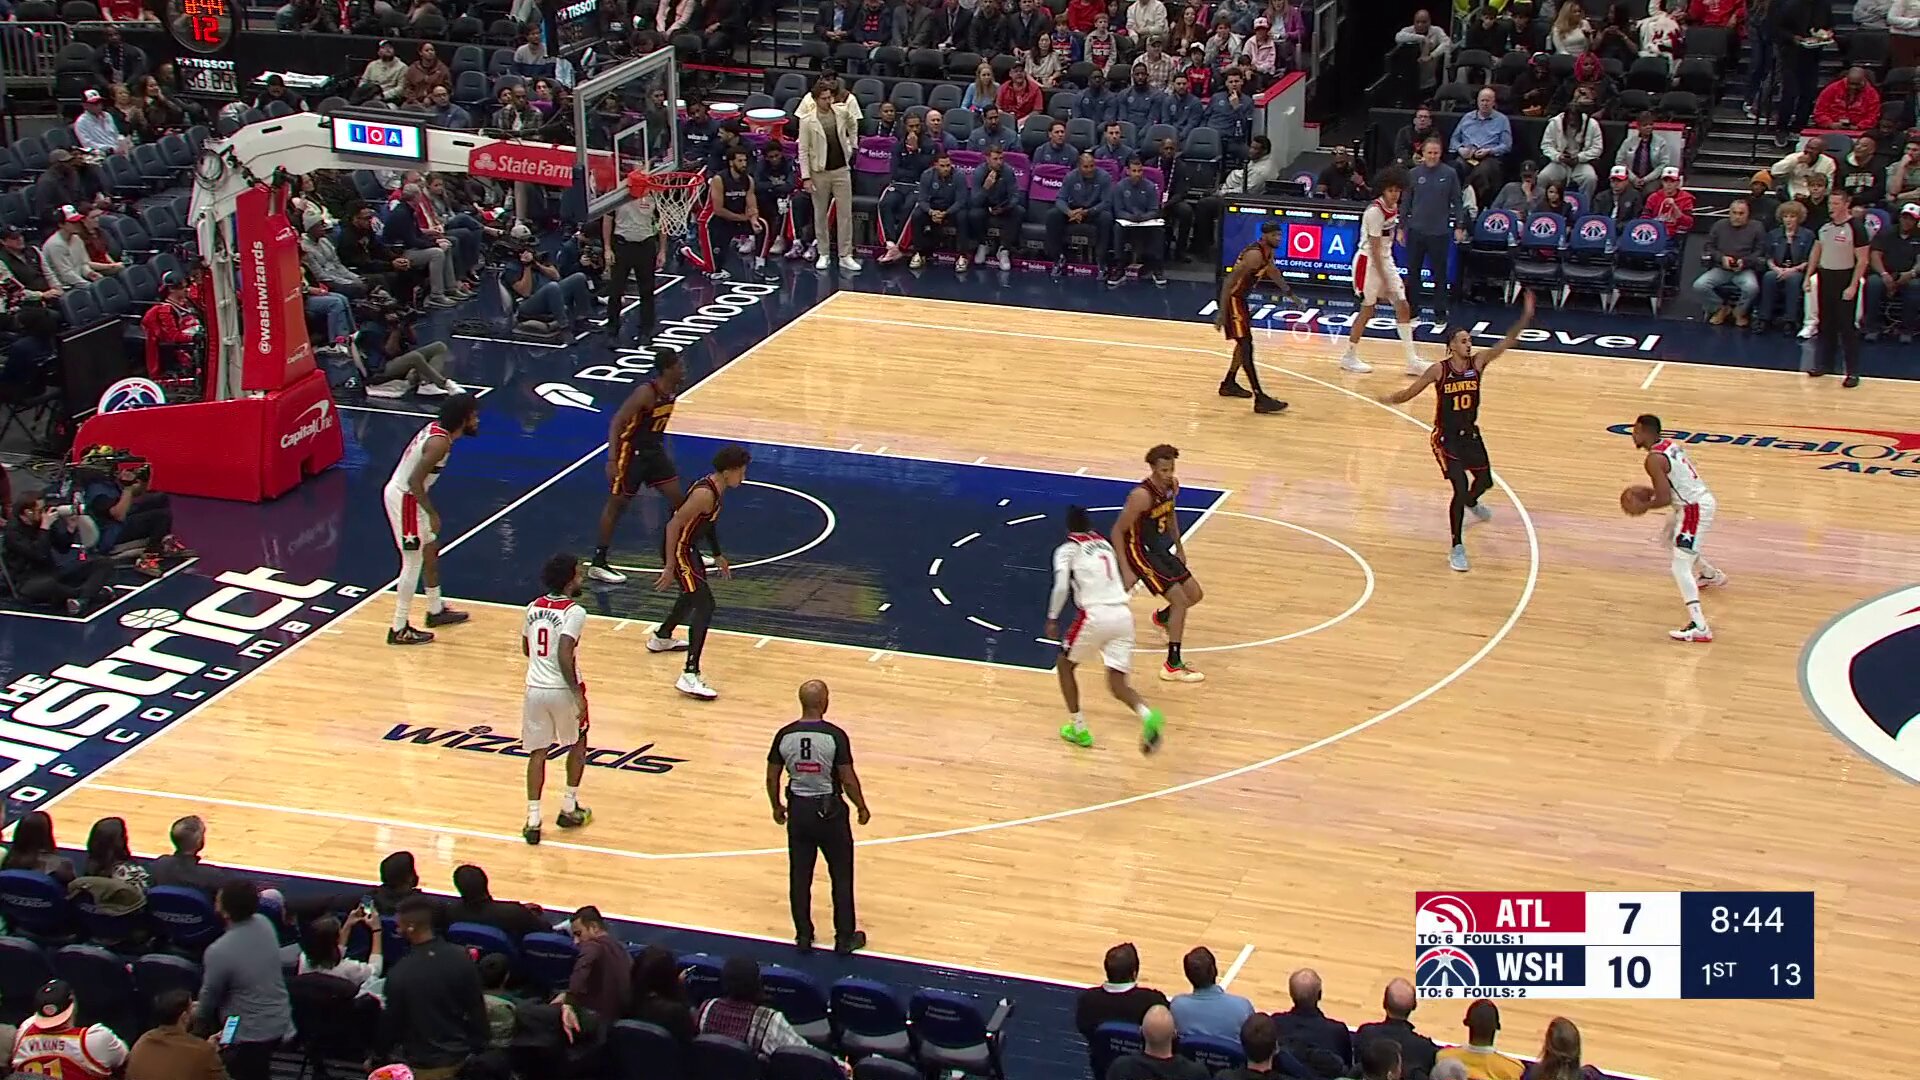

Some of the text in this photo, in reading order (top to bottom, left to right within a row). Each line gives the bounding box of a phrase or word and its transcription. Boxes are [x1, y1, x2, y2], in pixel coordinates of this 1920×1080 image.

[567, 0, 598, 19] TISSOT
[193, 16, 221, 42] 12
[191, 59, 235, 70] TISSOT
[1042, 177, 1063, 188] leido
[1290, 260, 1313, 268] OFFICE
[1324, 262, 1353, 271] AMERICA
[251, 240, 272, 355] @washwizards
[574, 280, 781, 384] Robinhood
[1469, 321, 1663, 352] Level
[1444, 380, 1478, 394] HAWKS
[1453, 394, 1472, 411] 10
[537, 628, 549, 657] 9
[9, 585, 368, 802] OF COLUMBIA
[800, 737, 812, 760] 8
